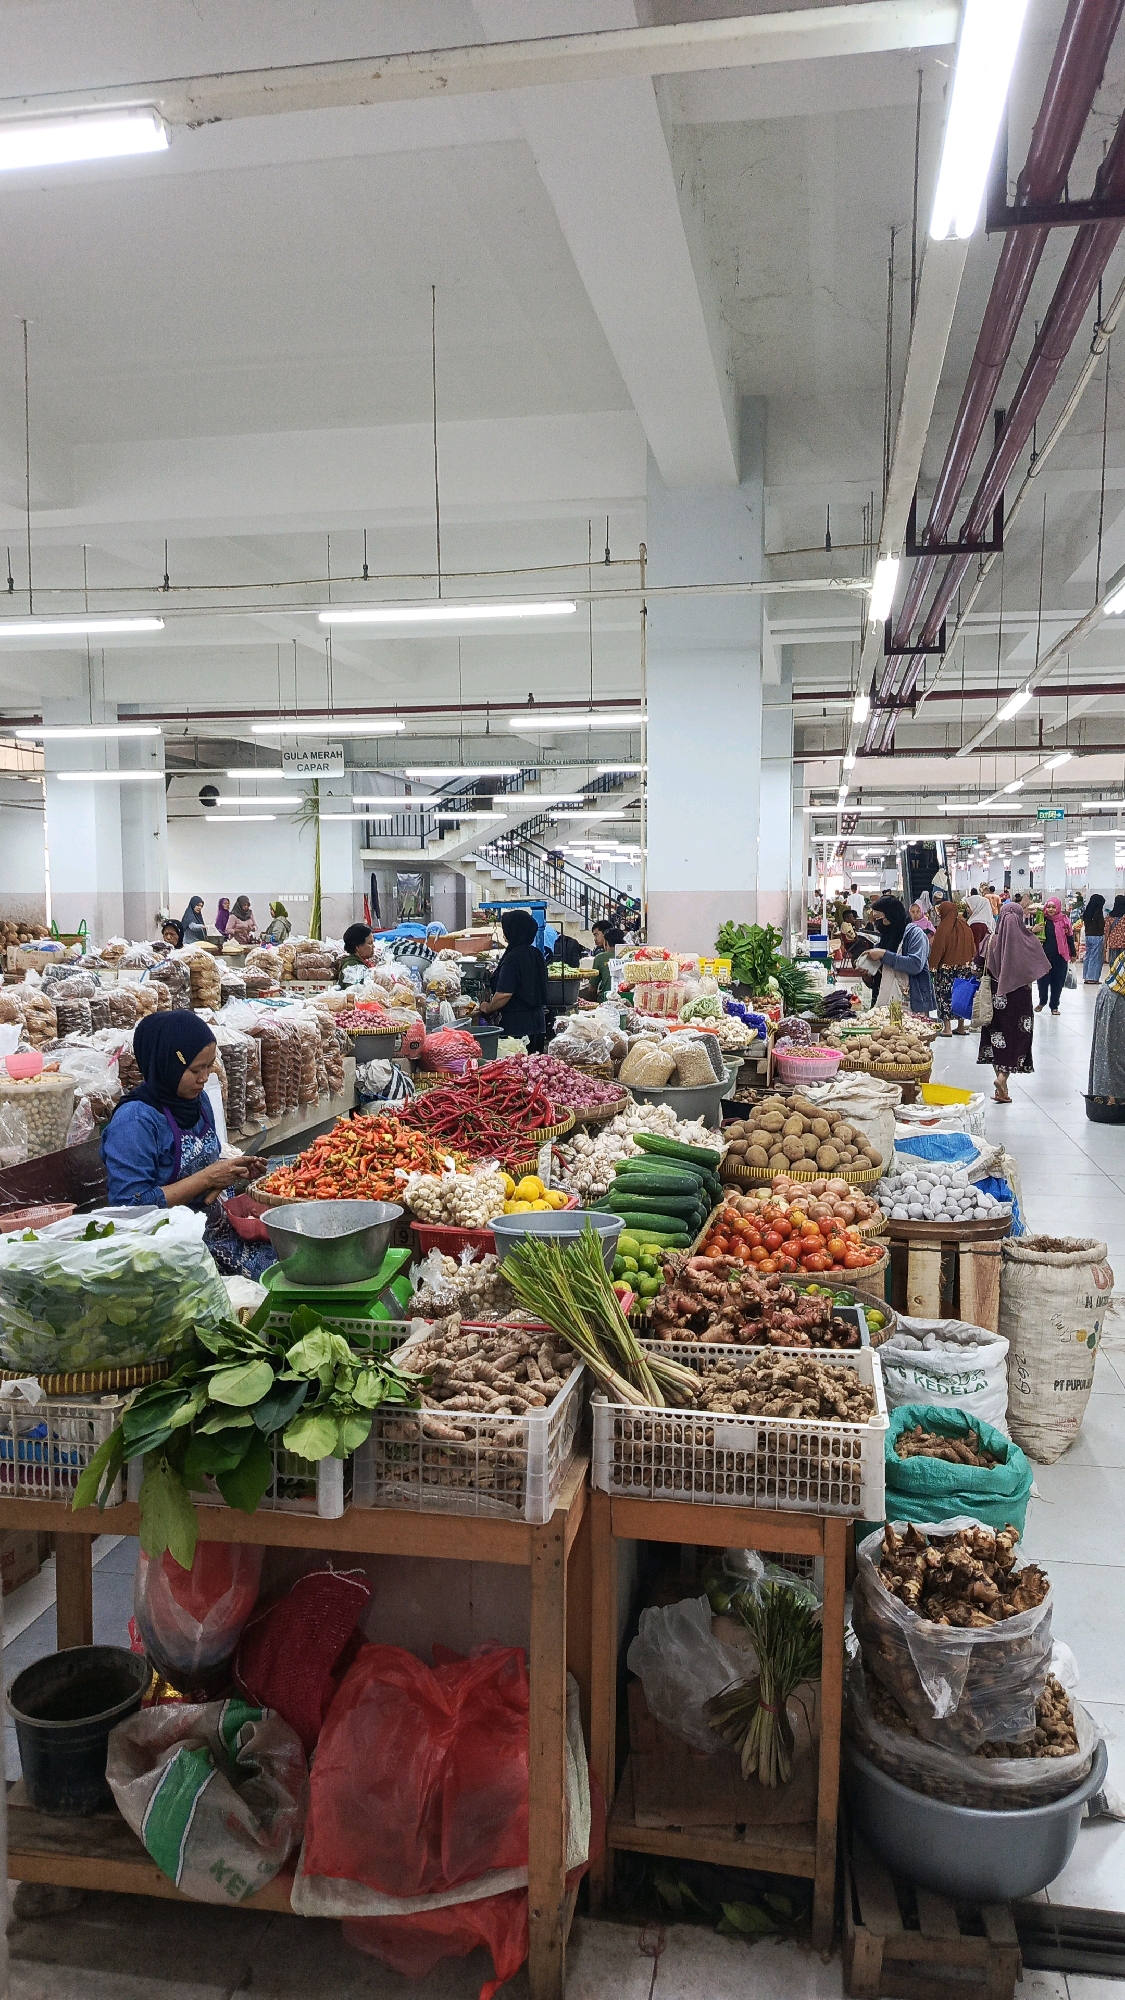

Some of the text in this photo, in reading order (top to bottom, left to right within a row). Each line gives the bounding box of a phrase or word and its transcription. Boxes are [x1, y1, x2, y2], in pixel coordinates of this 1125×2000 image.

[284, 751, 343, 760] GULA MERAH
[297, 763, 329, 771] CAPAR
[398, 1230, 409, 1244] 9
[913, 1371, 989, 1395] KEDELAI
[1053, 1379, 1065, 1391] PT
